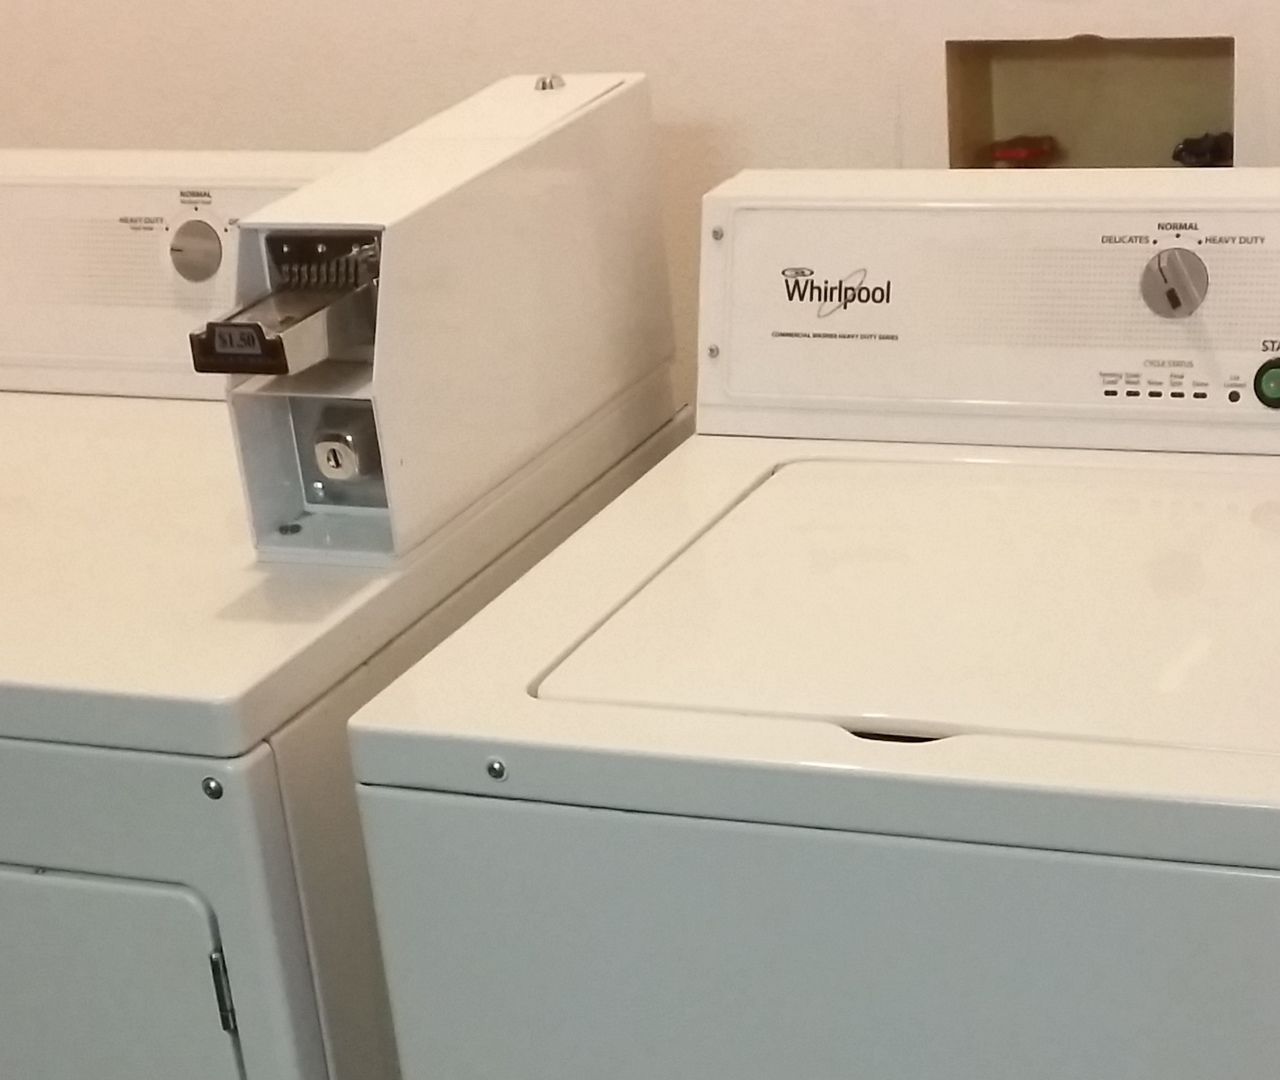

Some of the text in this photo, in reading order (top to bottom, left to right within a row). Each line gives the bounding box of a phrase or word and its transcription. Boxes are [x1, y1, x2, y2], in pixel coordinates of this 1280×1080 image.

[1157, 222, 1200, 231] NORMAL
[1100, 235, 1151, 244] DELICATES
[1204, 235, 1266, 245] HEAVY DUTY
[784, 278, 891, 310] Whirlpool
[217, 331, 257, 350] $1.50
